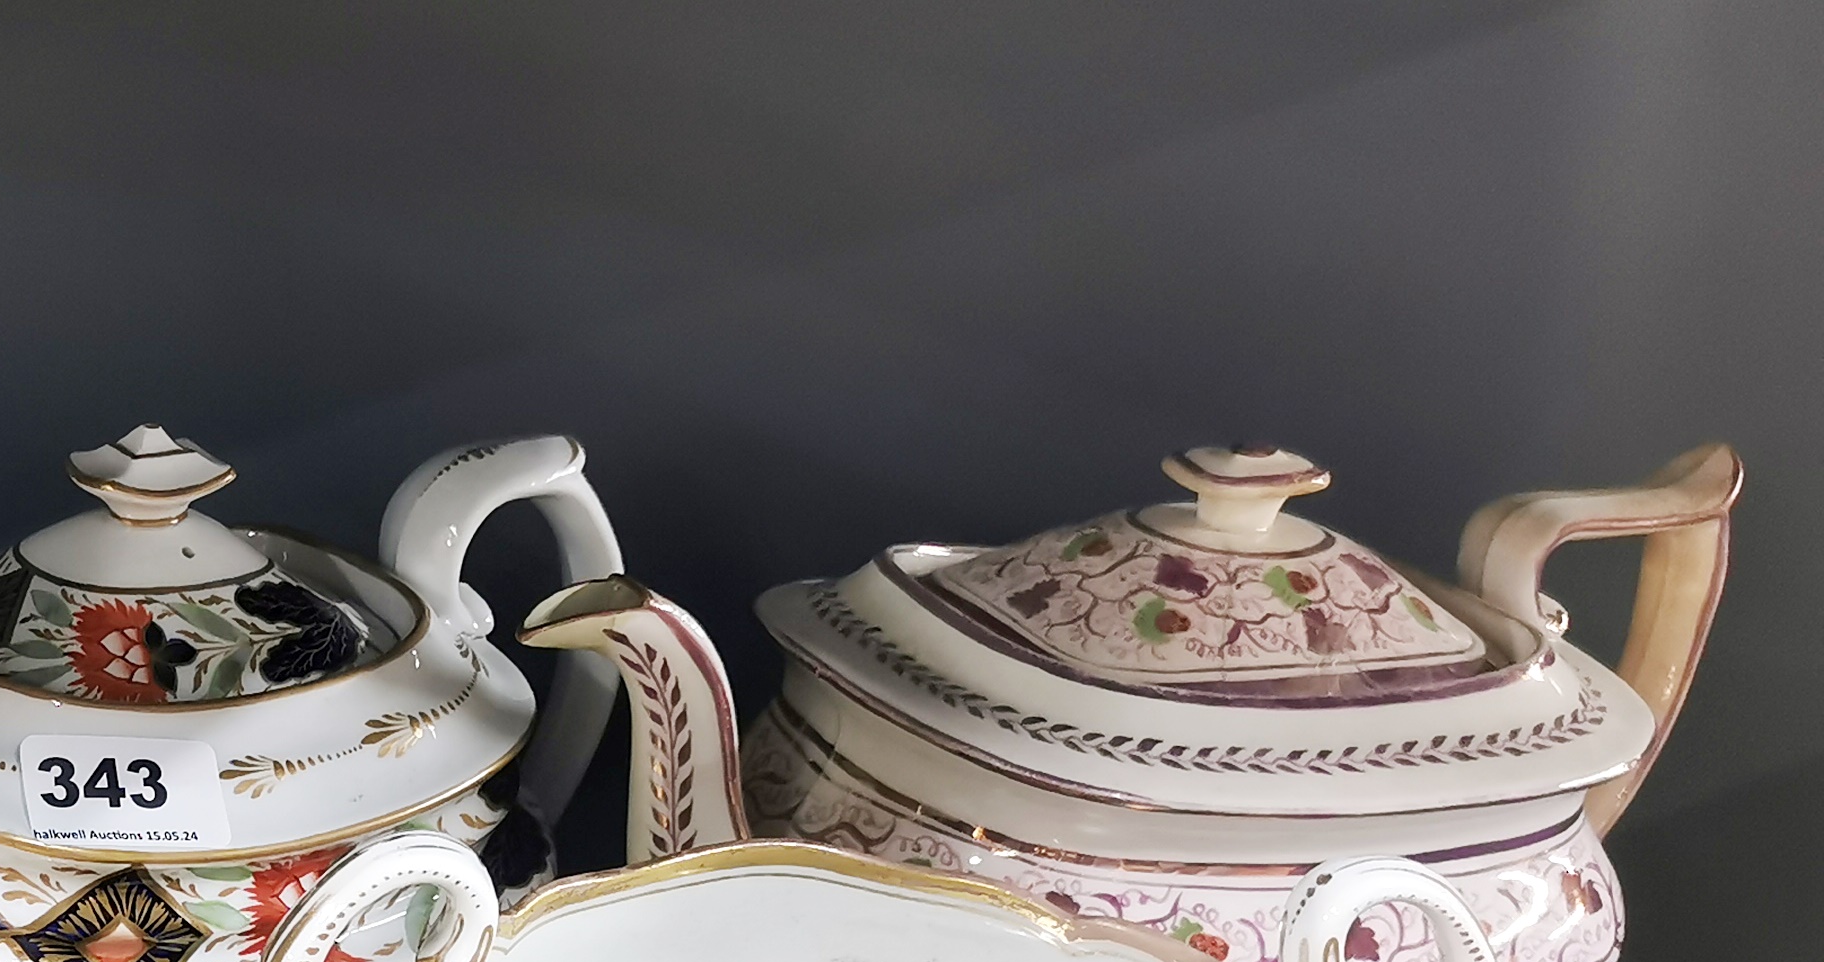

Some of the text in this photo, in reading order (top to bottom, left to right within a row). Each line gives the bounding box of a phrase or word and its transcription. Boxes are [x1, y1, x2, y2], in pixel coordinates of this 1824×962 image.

[38, 757, 168, 809] 343
[90, 830, 143, 841] Auctions
[147, 831, 199, 842] 15.05.24
